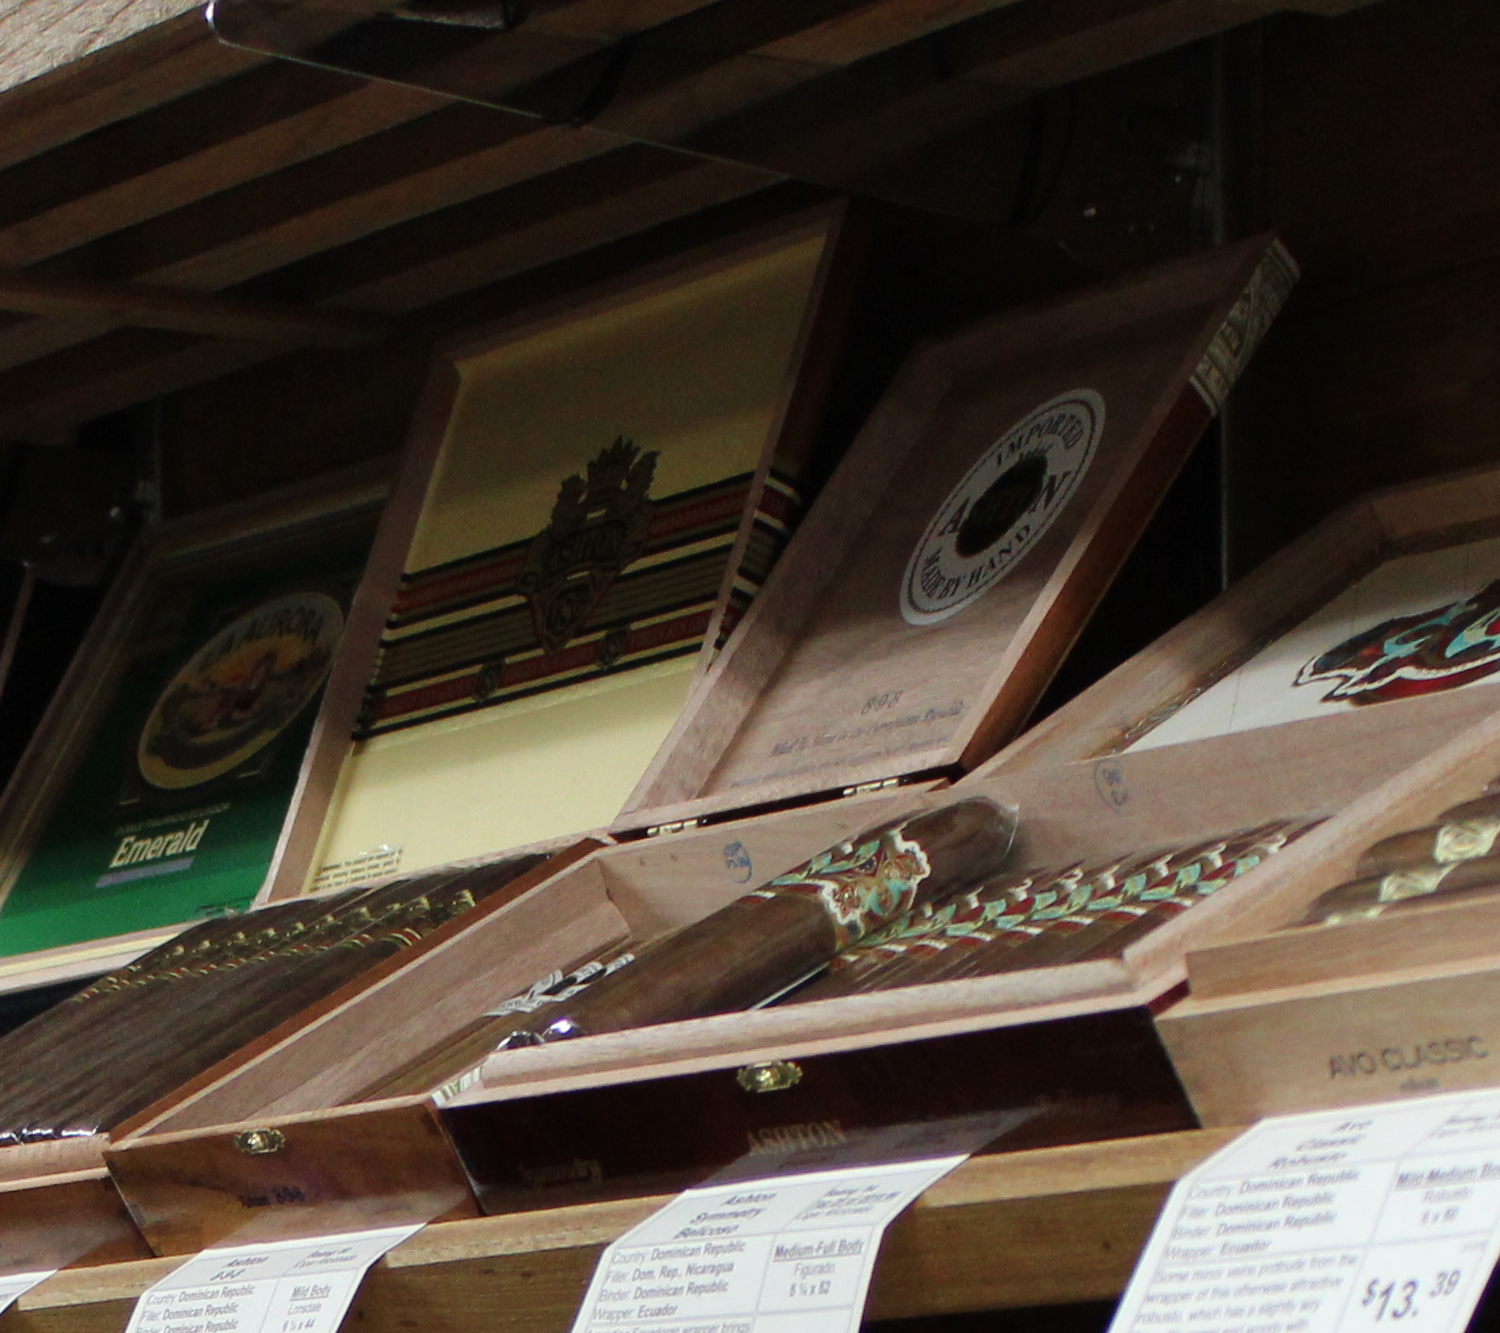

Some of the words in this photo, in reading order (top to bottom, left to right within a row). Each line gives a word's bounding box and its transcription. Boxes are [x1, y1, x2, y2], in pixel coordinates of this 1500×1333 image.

[997, 413, 1085, 468] IMPORTED
[966, 525, 1030, 590] HAND
[109, 819, 210, 869] Emerald
[1326, 1044, 1375, 1080] AVO
[1380, 1035, 1491, 1075] CLASSIC
[836, 1237, 864, 1255] Body
[1361, 1269, 1463, 1324] $13.39
